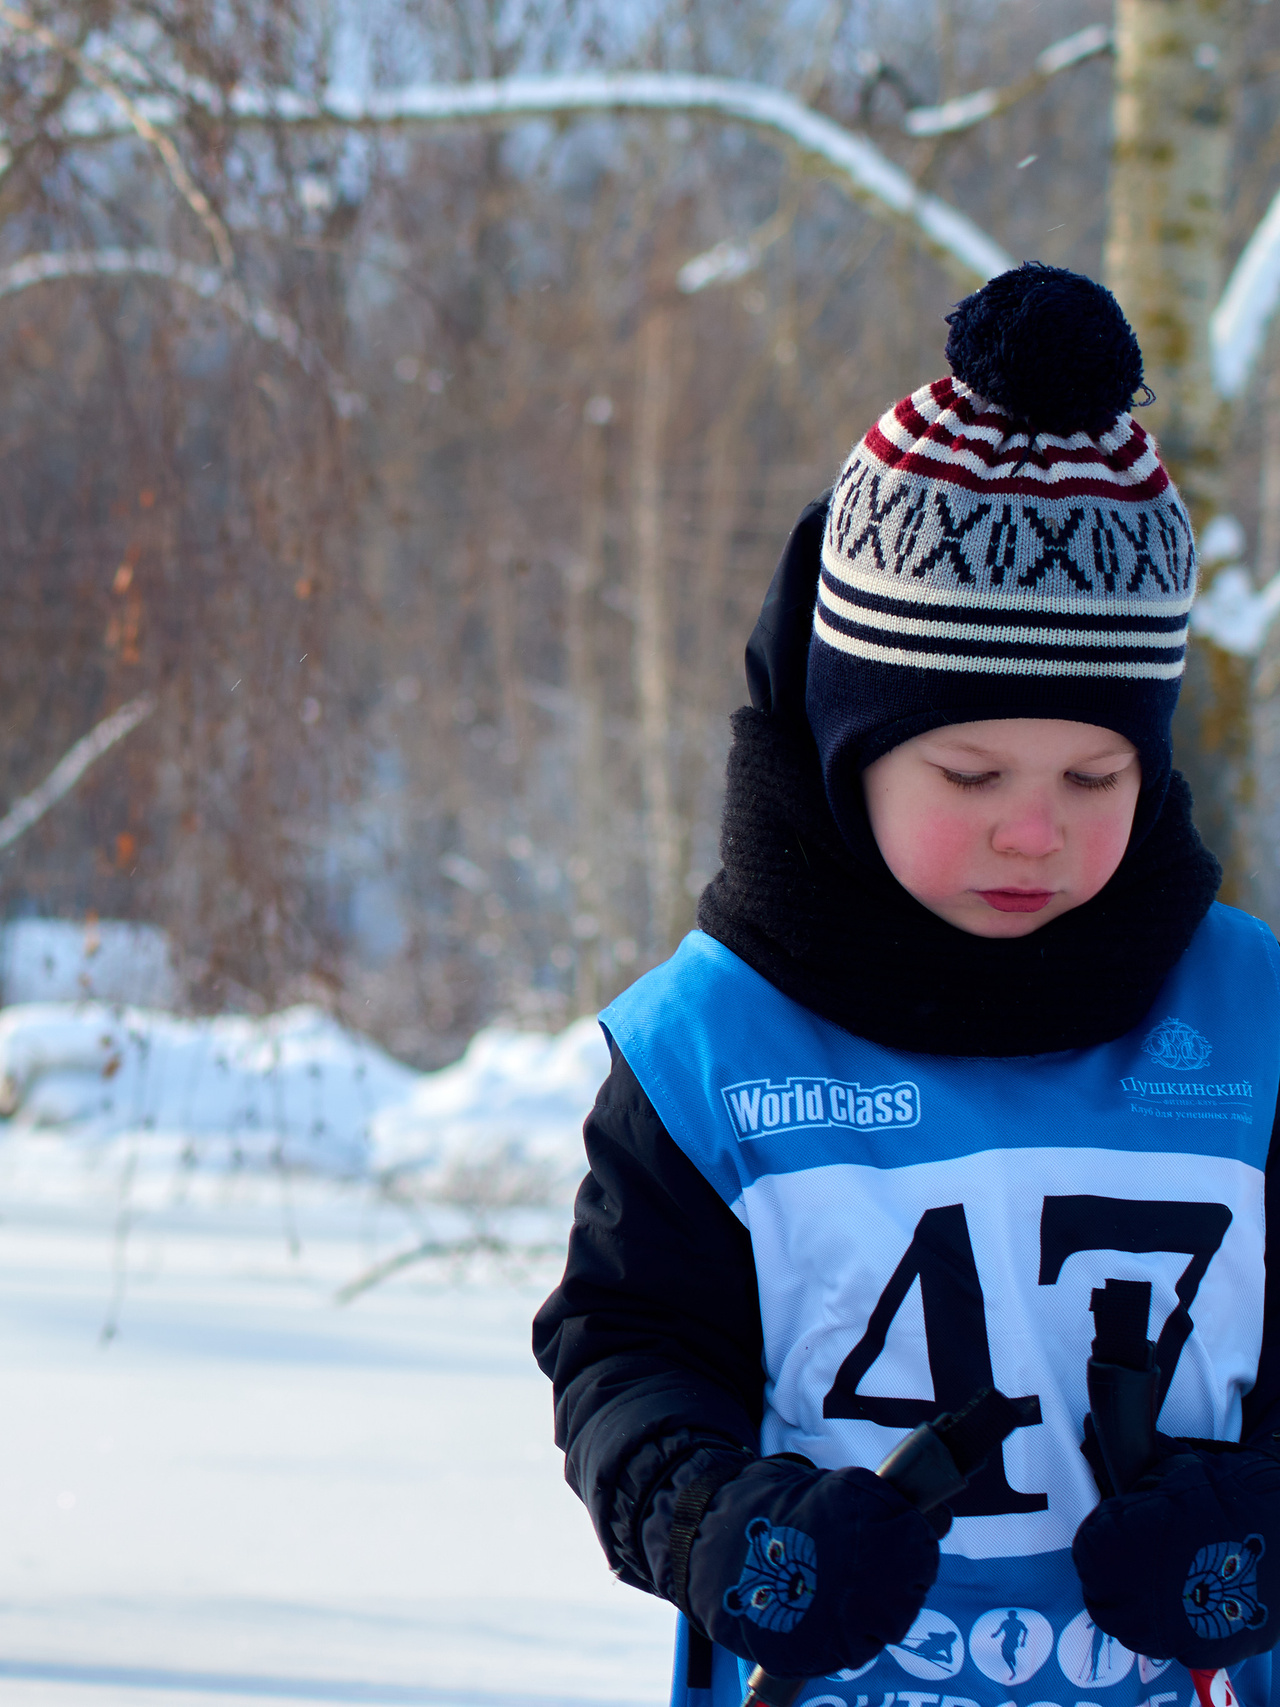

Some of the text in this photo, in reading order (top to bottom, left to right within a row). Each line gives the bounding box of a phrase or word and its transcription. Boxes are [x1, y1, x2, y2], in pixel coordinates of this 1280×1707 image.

[1120, 1076, 1253, 1098] Пушкинский
[729, 1083, 913, 1133] World Class
[1130, 1103, 1154, 1118] Клуб
[1155, 1108, 1173, 1119] для
[1175, 1111, 1229, 1121] успешных
[822, 1194, 1234, 1518] 47
